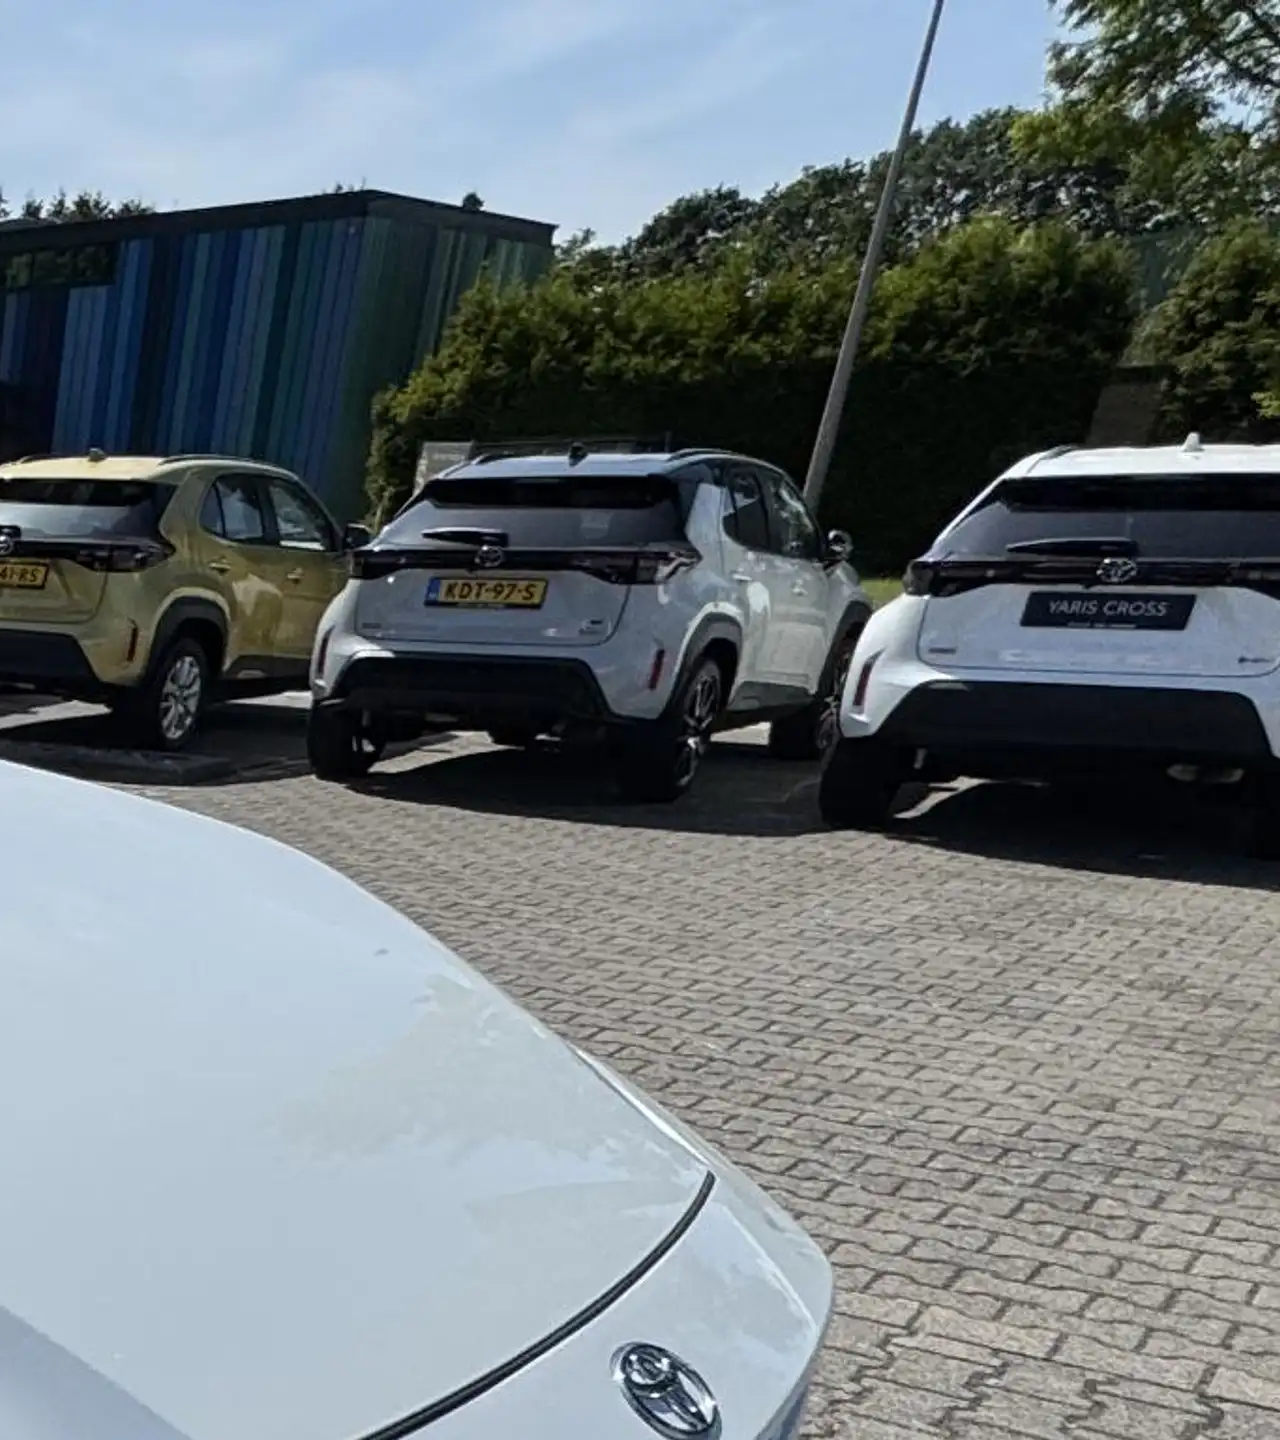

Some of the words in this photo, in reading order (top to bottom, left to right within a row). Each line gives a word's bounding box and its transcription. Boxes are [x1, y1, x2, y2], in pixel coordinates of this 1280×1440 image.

[443, 581, 537, 601] KDT-97-S
[1048, 600, 1099, 616] YARIS
[1102, 600, 1169, 617] CROSS
